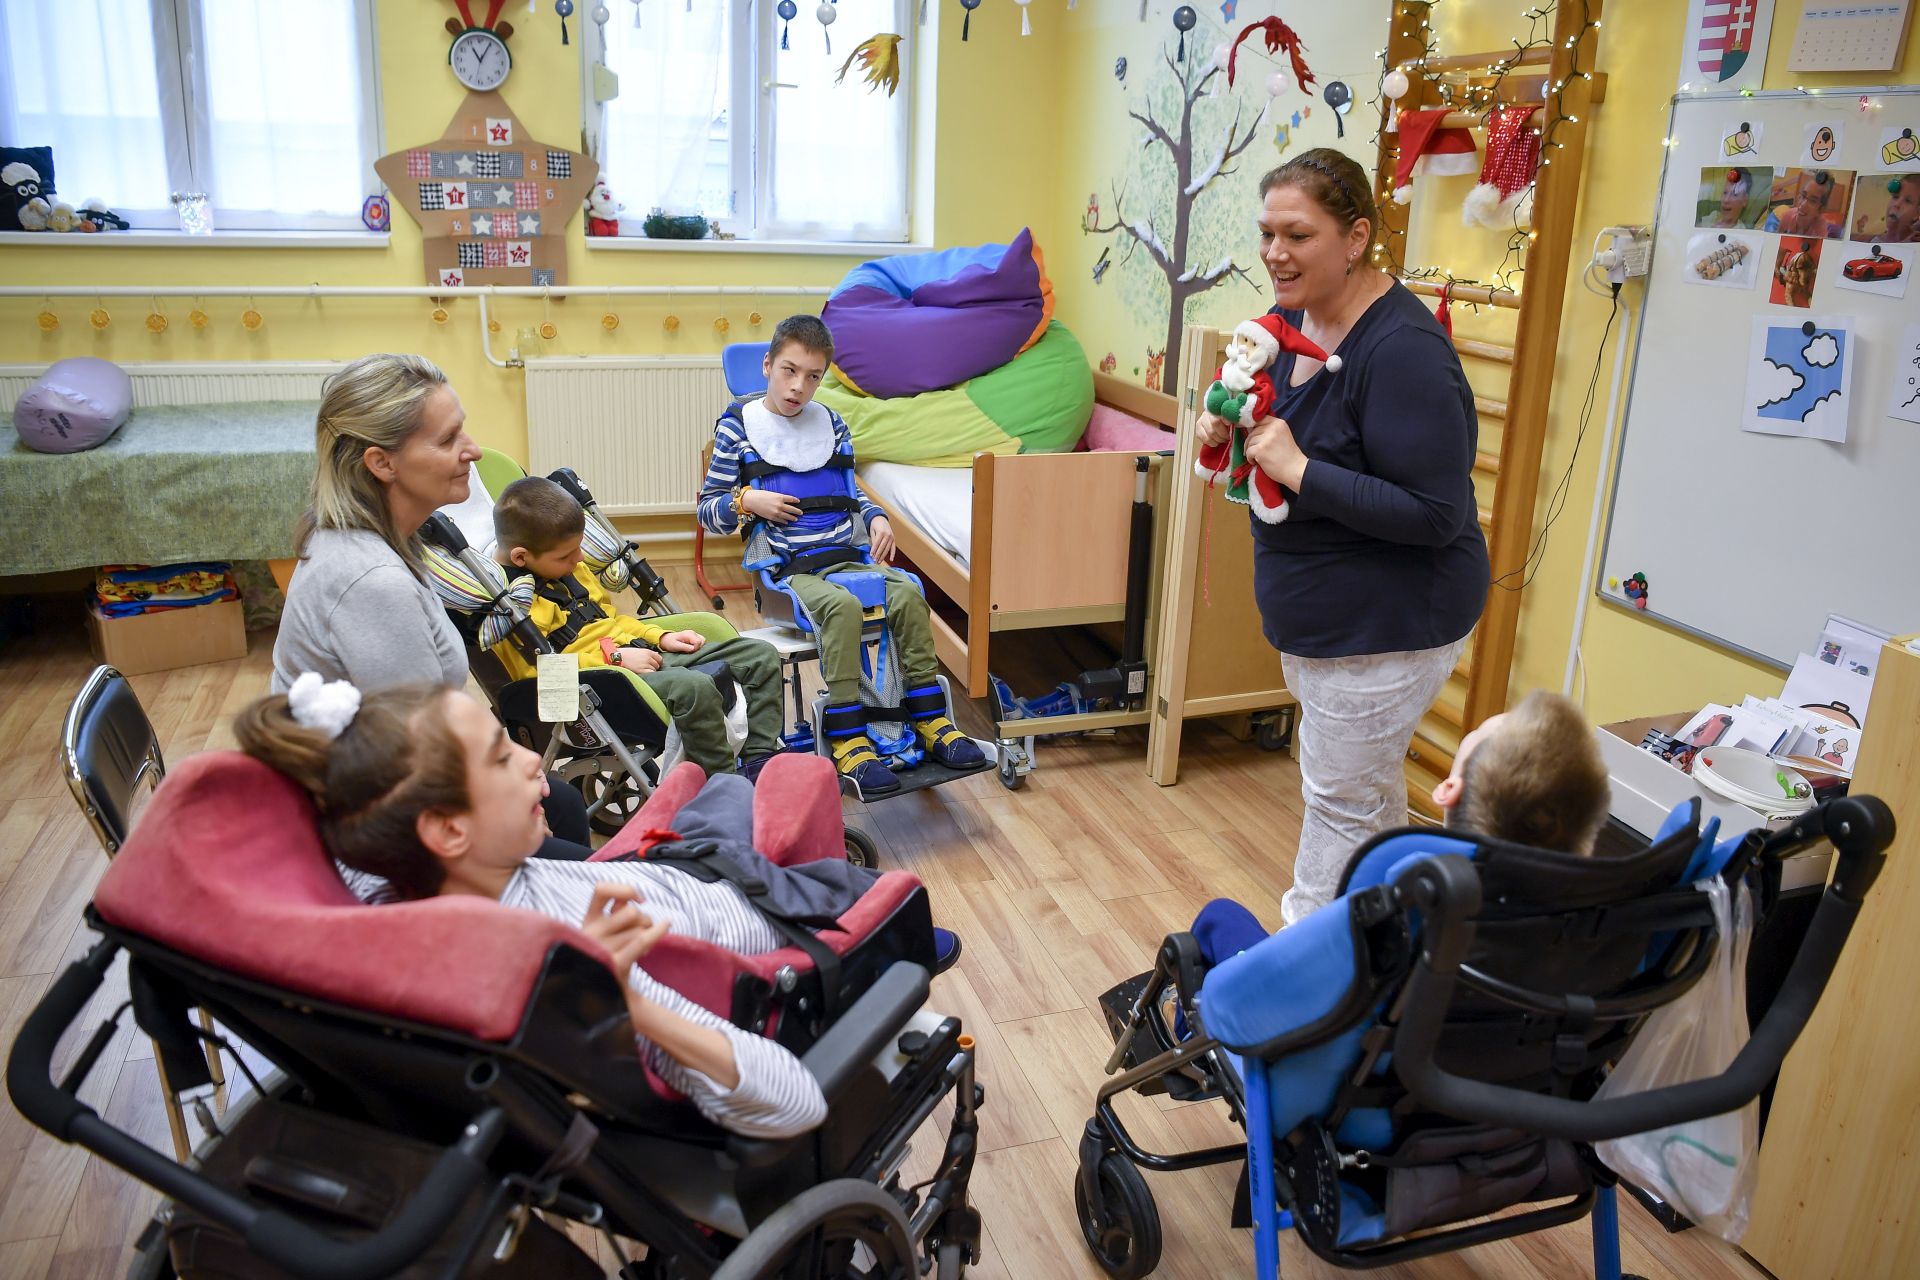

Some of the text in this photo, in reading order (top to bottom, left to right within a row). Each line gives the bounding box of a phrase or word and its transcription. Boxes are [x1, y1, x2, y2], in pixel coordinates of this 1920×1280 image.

[495, 127, 503, 138] 2
[530, 160, 537, 171] 8
[514, 250, 525, 261] 23
